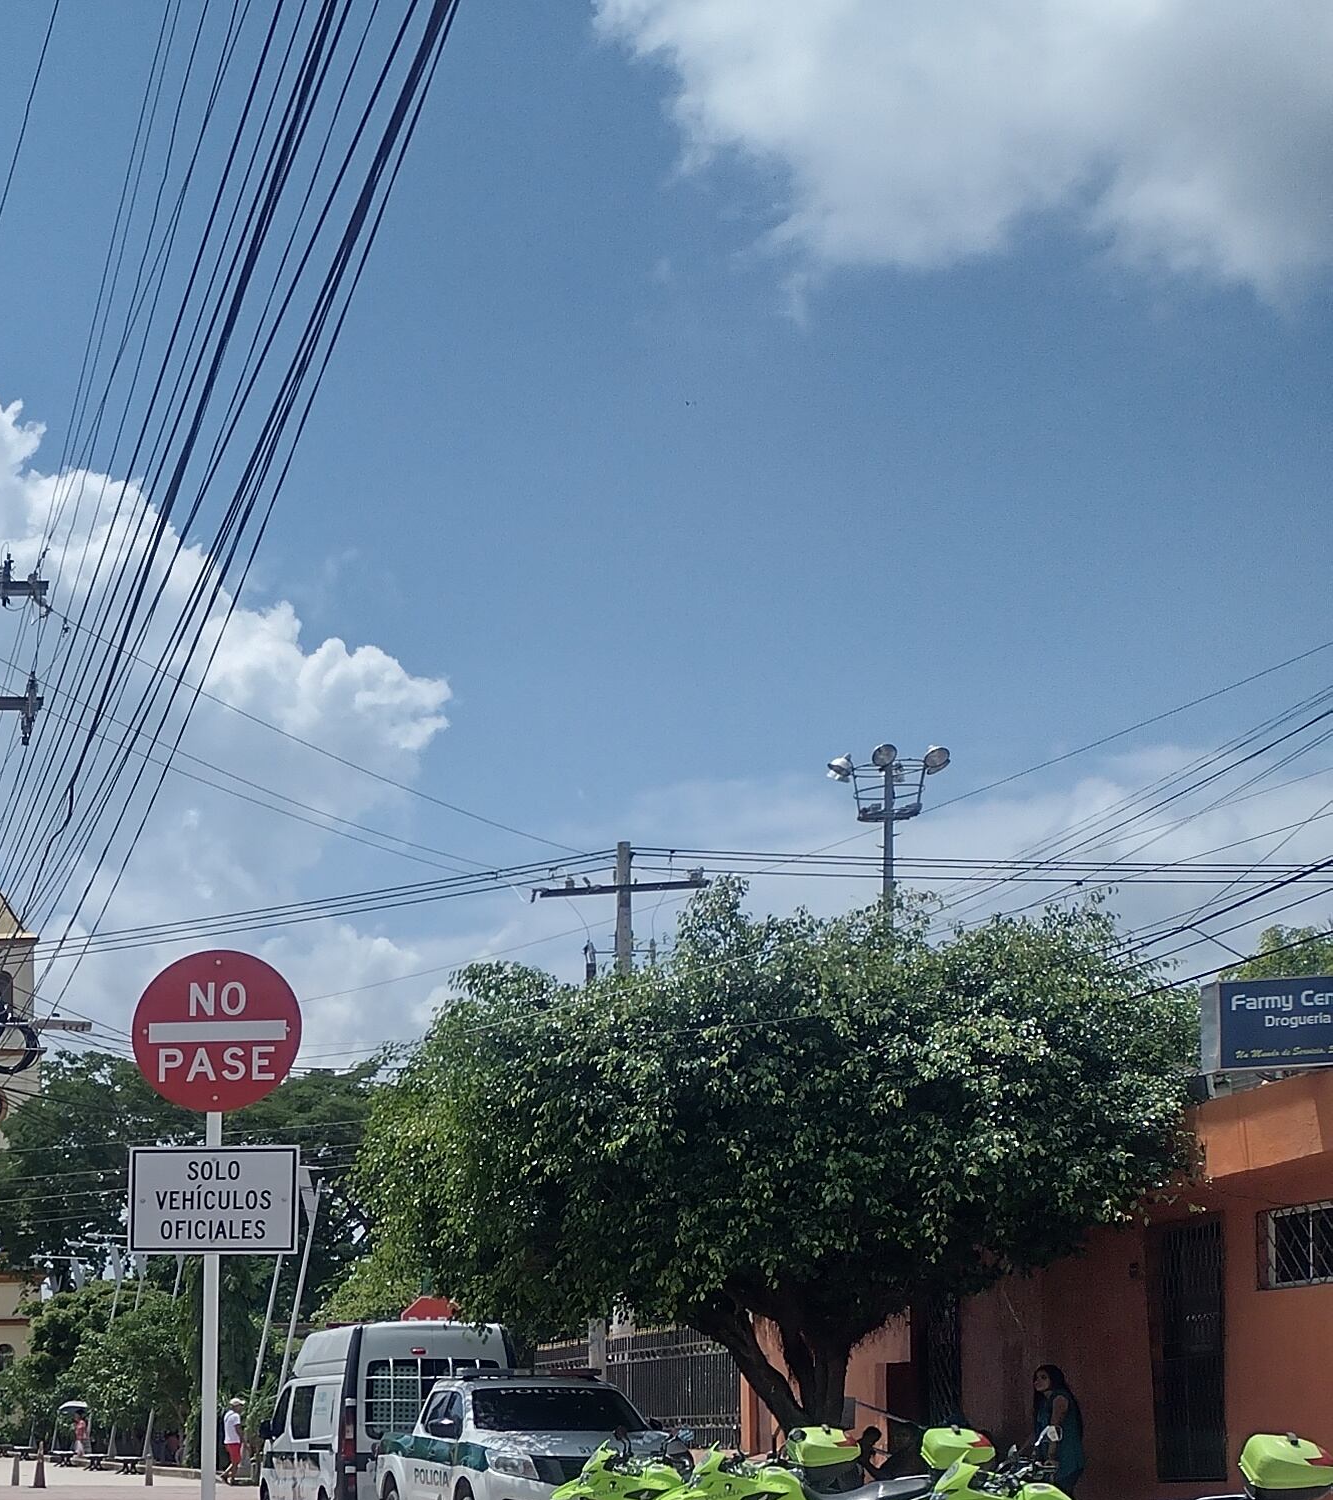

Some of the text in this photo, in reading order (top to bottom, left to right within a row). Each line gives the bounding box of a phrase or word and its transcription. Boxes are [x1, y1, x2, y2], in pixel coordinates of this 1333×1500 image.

[189, 982, 247, 1017] NO
[1232, 994, 1293, 1012] Farmy
[1264, 1012, 1332, 1028] Droguería
[158, 1046, 276, 1083] PASE
[187, 1160, 241, 1181] SOLO
[156, 1184, 273, 1211] VEHÍCULOS
[160, 1219, 266, 1241] OFICIALES
[414, 1467, 450, 1488] POLICIA
